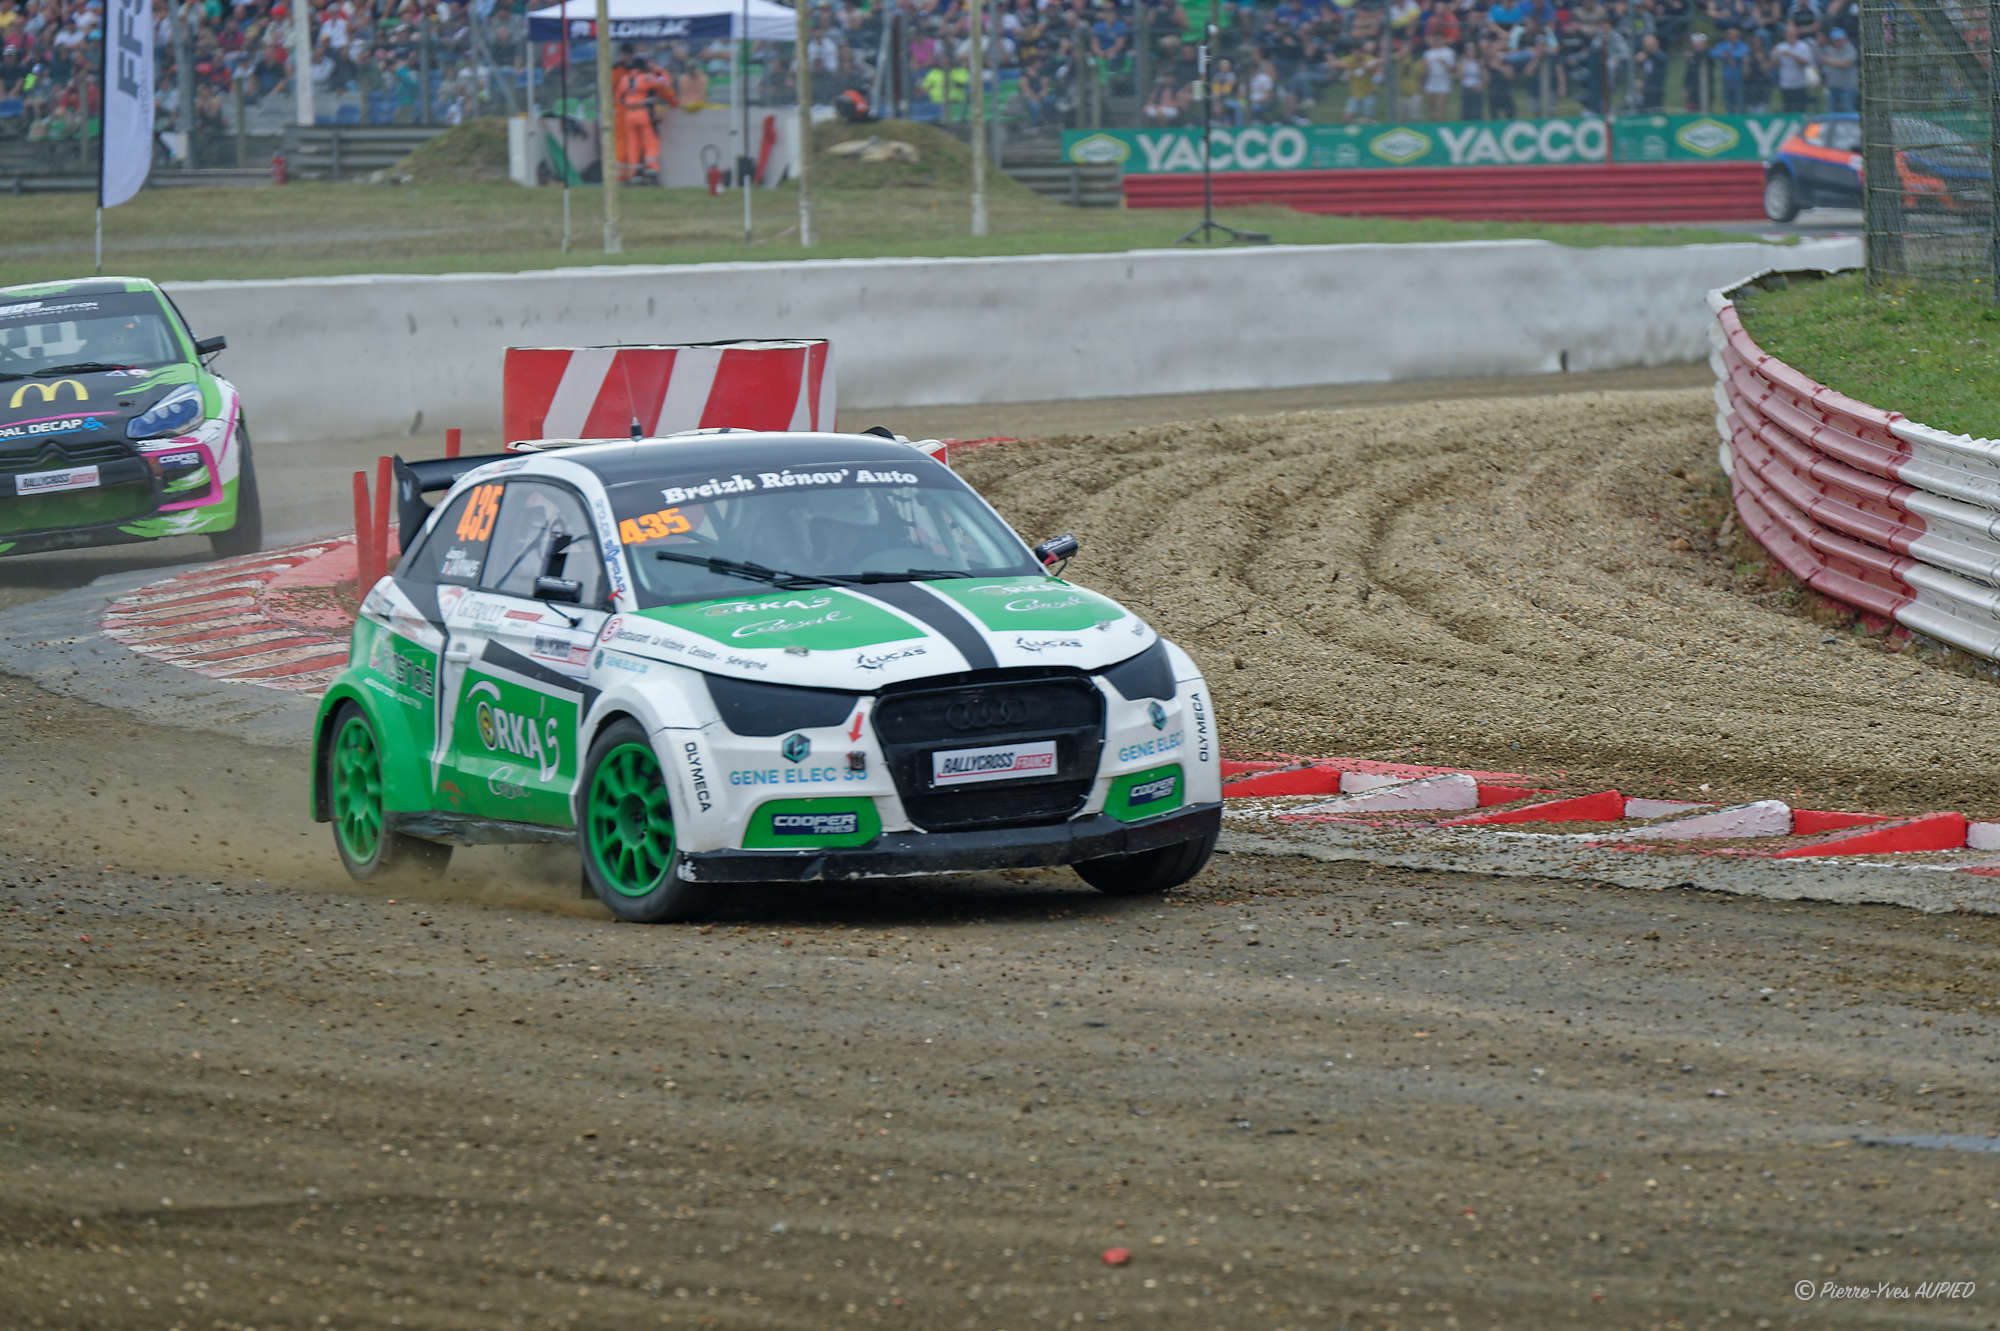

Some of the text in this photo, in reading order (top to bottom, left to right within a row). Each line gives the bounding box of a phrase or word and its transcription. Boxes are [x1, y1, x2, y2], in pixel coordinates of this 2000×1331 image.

[1136, 127, 1308, 171] YACCO
[1437, 120, 1610, 164] YACCO
[27, 419, 83, 434] DECAP
[661, 468, 919, 505] Breizh Rénov' Auto
[455, 484, 505, 542] 435
[618, 507, 692, 545] 435
[1190, 692, 1209, 762] OLYMECA
[942, 752, 1014, 773] RALLYCROSS
[1119, 740, 1155, 762] GENE
[684, 742, 713, 813] OLYMECA
[729, 769, 780, 786] GENE
[784, 768, 838, 784] ELEC
[1130, 777, 1176, 797] COOPER
[773, 814, 857, 828] COOPER
